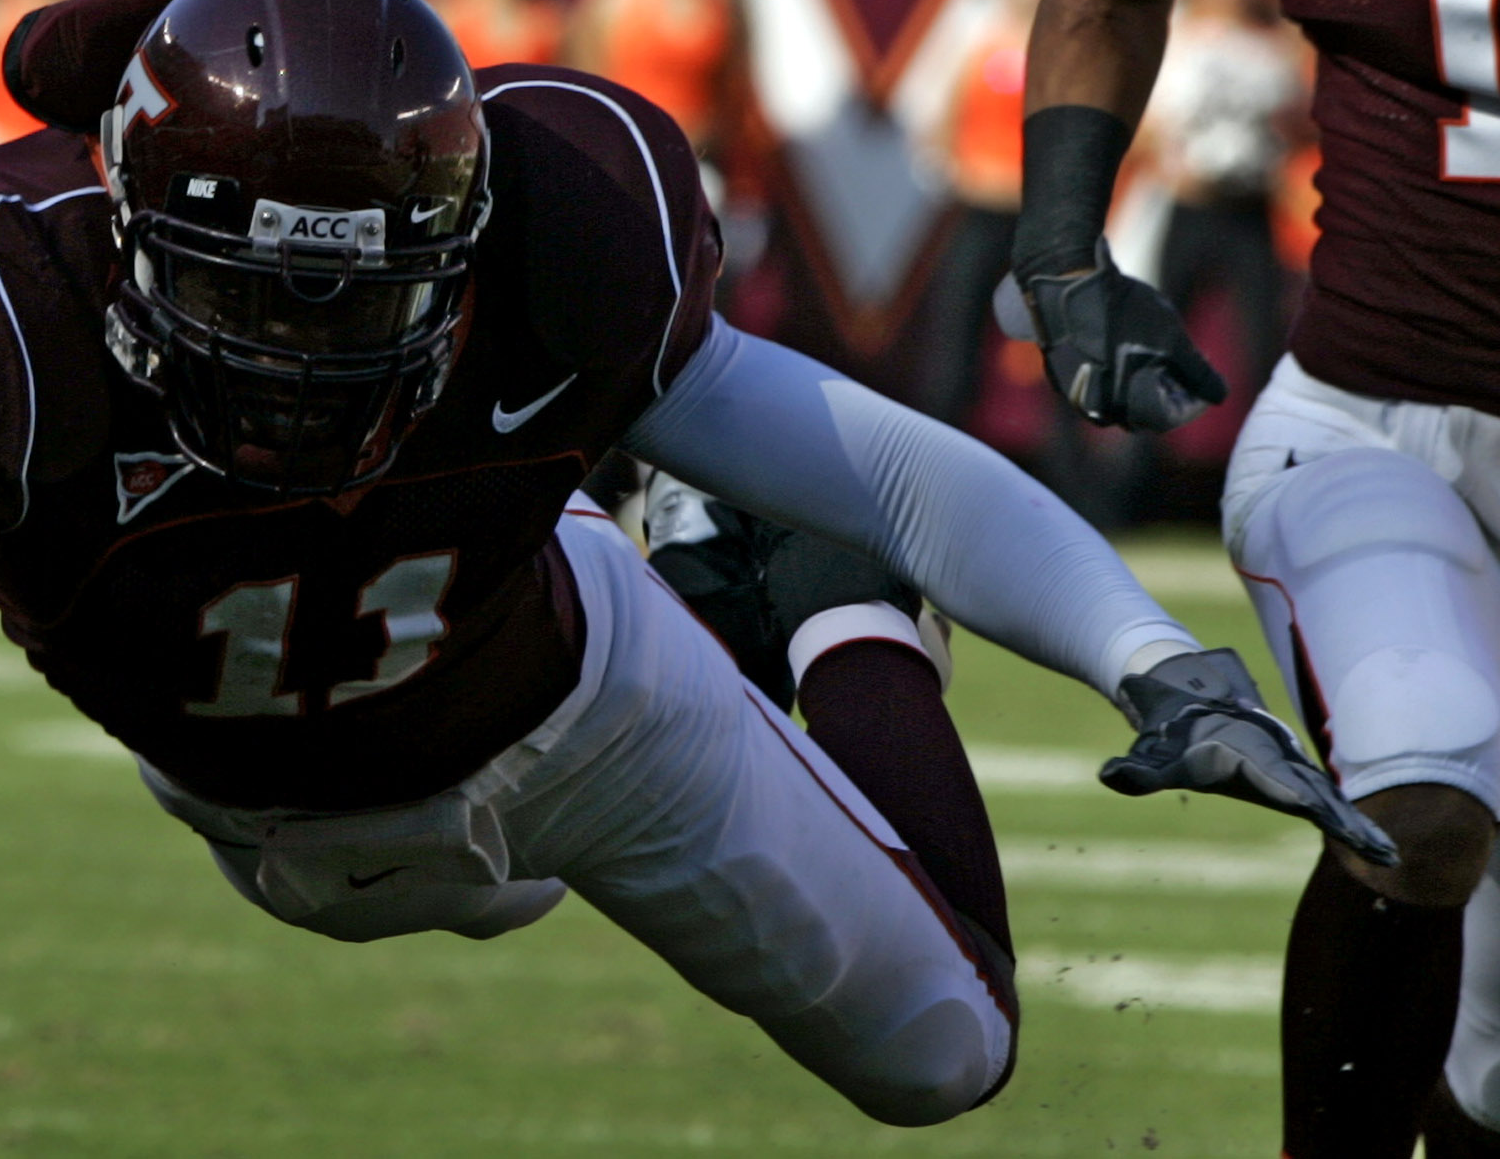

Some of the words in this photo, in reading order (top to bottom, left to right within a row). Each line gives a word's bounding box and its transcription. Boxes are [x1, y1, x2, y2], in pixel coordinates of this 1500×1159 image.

[186, 177, 218, 199] NIKE
[290, 216, 350, 240] ACC
[183, 548, 458, 718] 11
